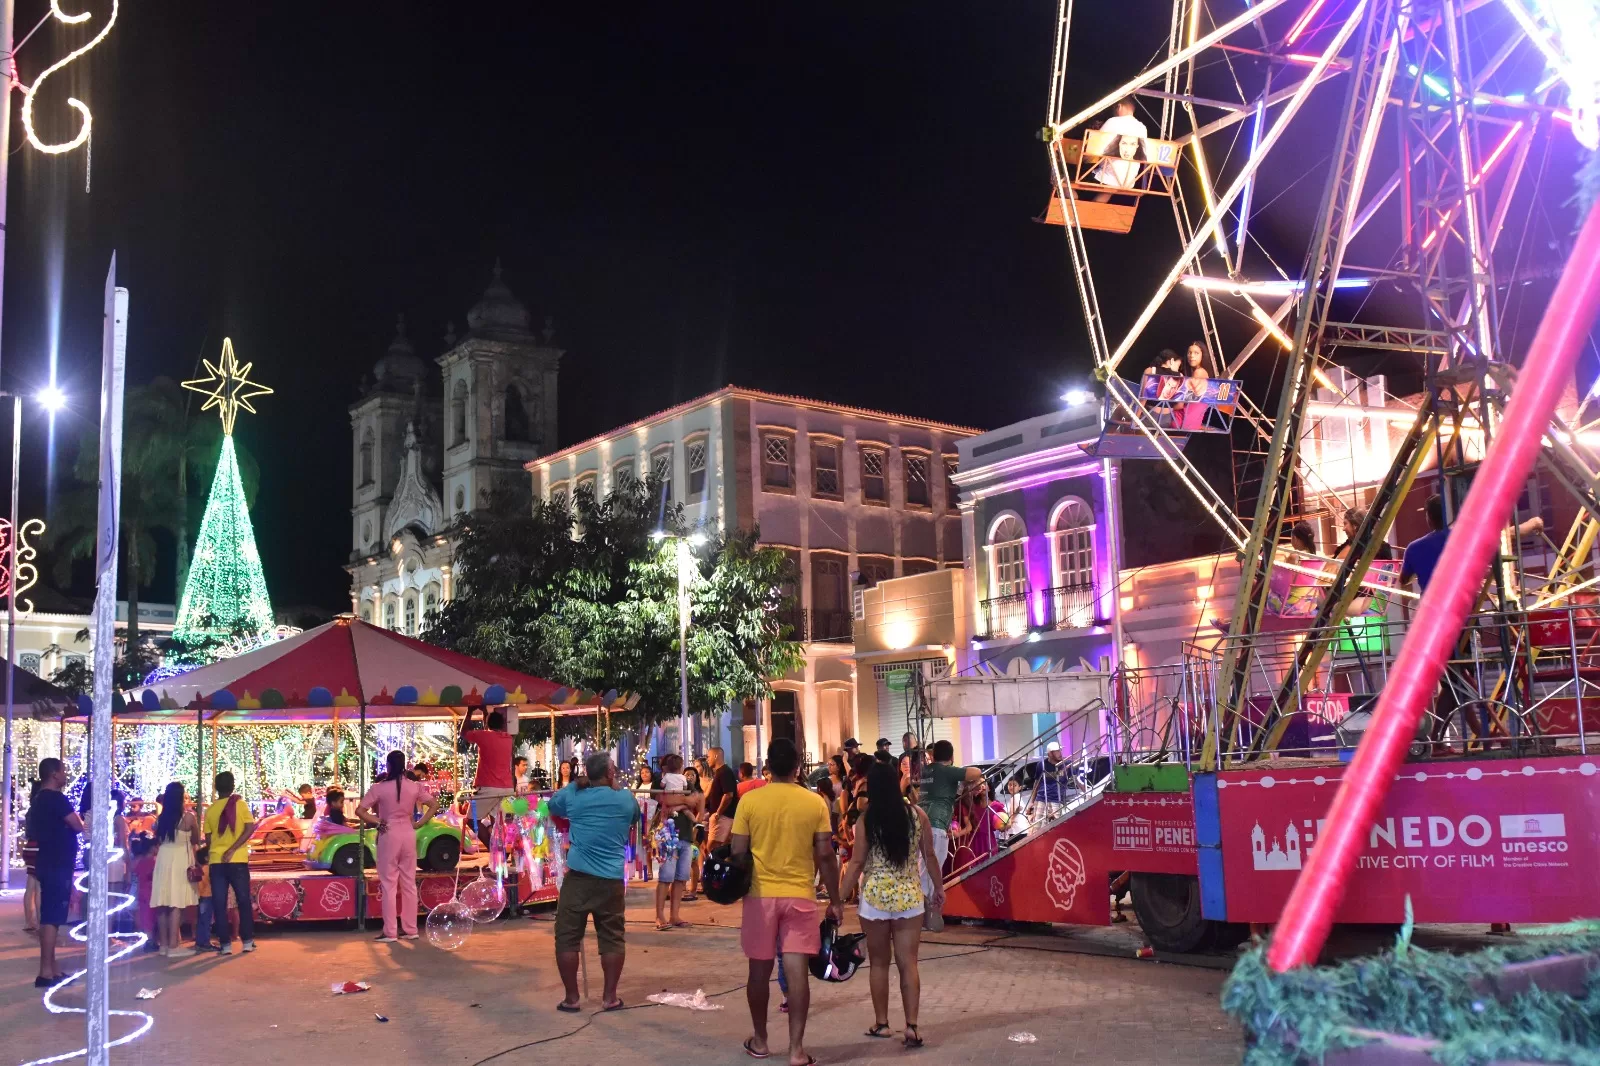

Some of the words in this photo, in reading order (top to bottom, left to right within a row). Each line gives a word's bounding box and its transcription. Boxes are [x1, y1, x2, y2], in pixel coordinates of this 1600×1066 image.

[1159, 145, 1170, 162] 12
[1217, 383, 1231, 400] 11
[1317, 814, 1492, 849] NEDO
[1501, 841, 1569, 853] unesco
[1356, 855, 1390, 869] TIVE
[1393, 855, 1429, 869] CITY
[1434, 854, 1457, 868] OF
[1461, 854, 1495, 868] FILM
